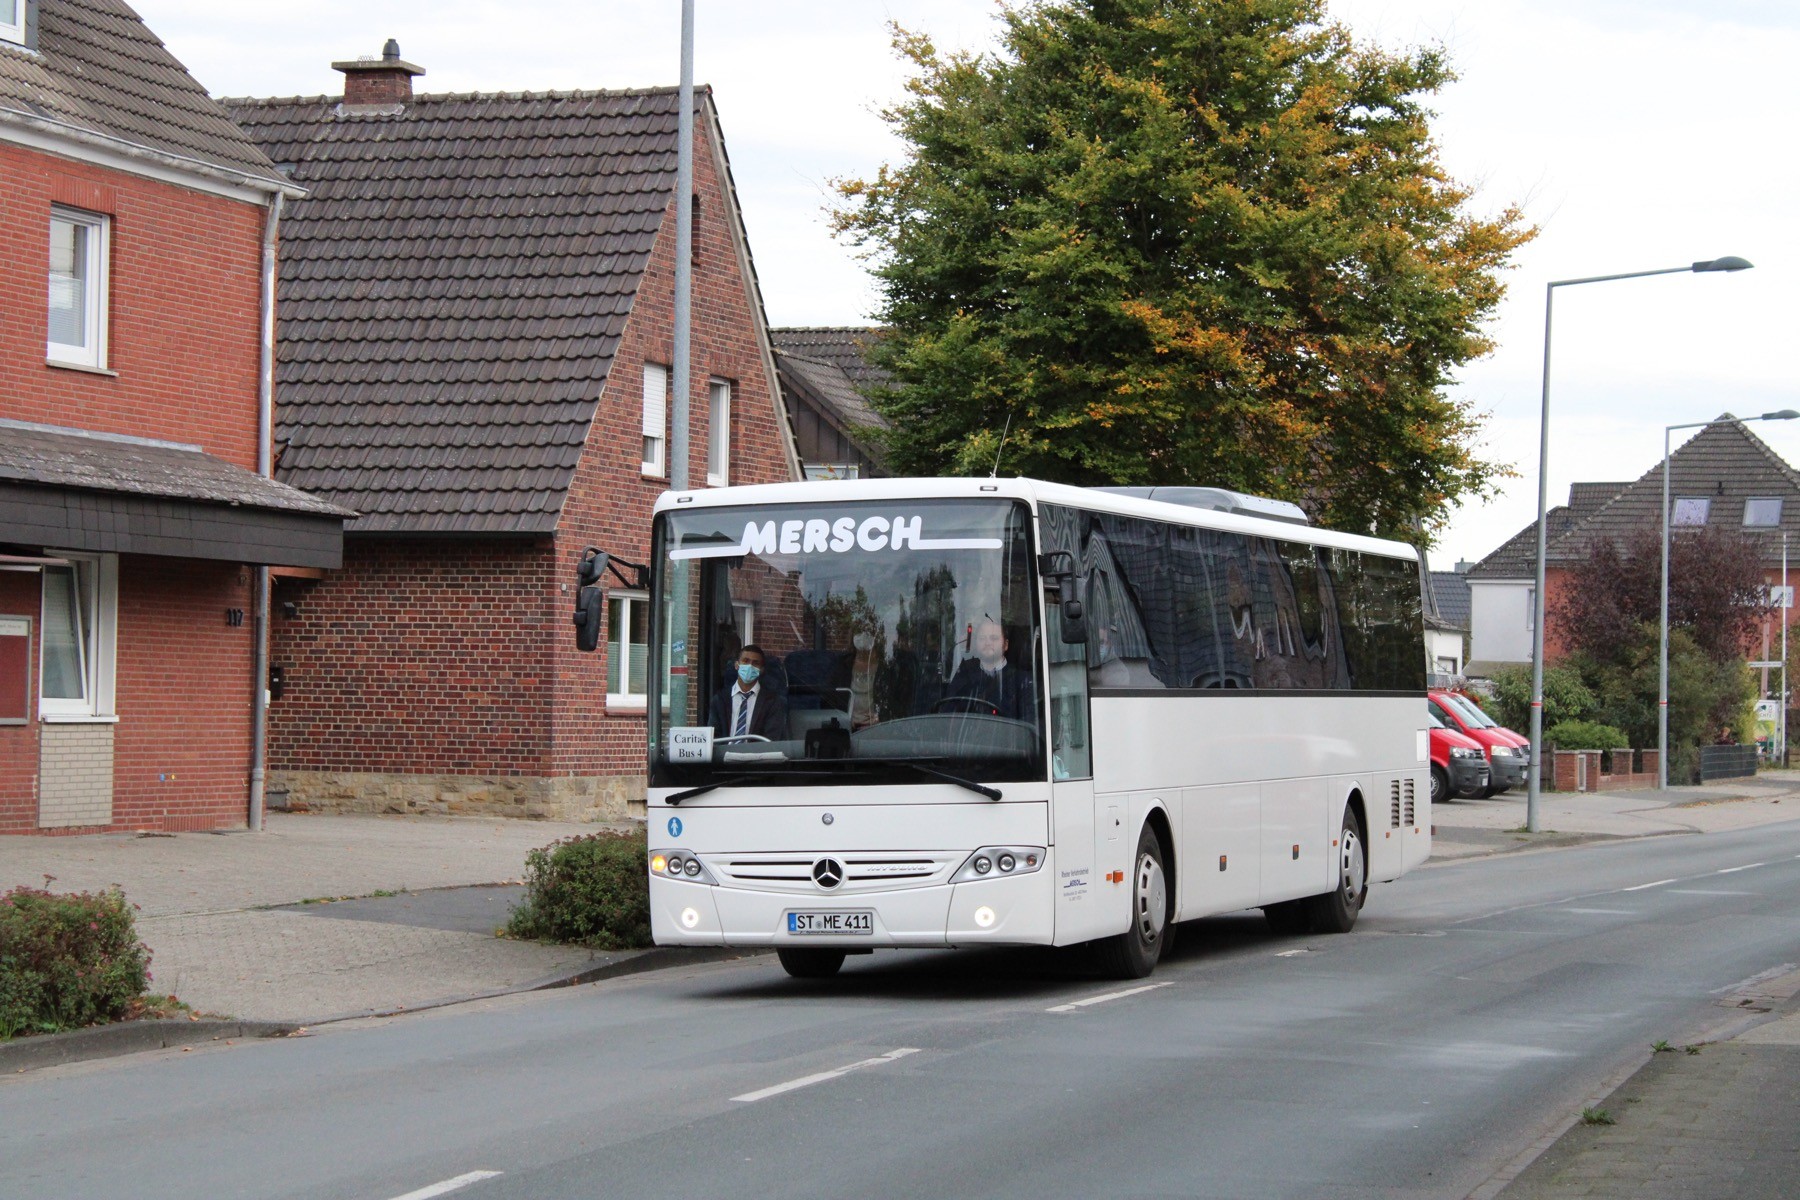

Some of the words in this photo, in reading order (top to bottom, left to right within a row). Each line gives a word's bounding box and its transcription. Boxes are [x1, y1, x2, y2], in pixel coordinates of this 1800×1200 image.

[739, 514, 923, 556] MERSCH
[674, 733, 707, 744] Caritas
[678, 748, 695, 758] Bus
[697, 748, 703, 758] 4
[797, 915, 815, 929] ST
[823, 915, 842, 929] ME
[844, 915, 870, 929] 411
